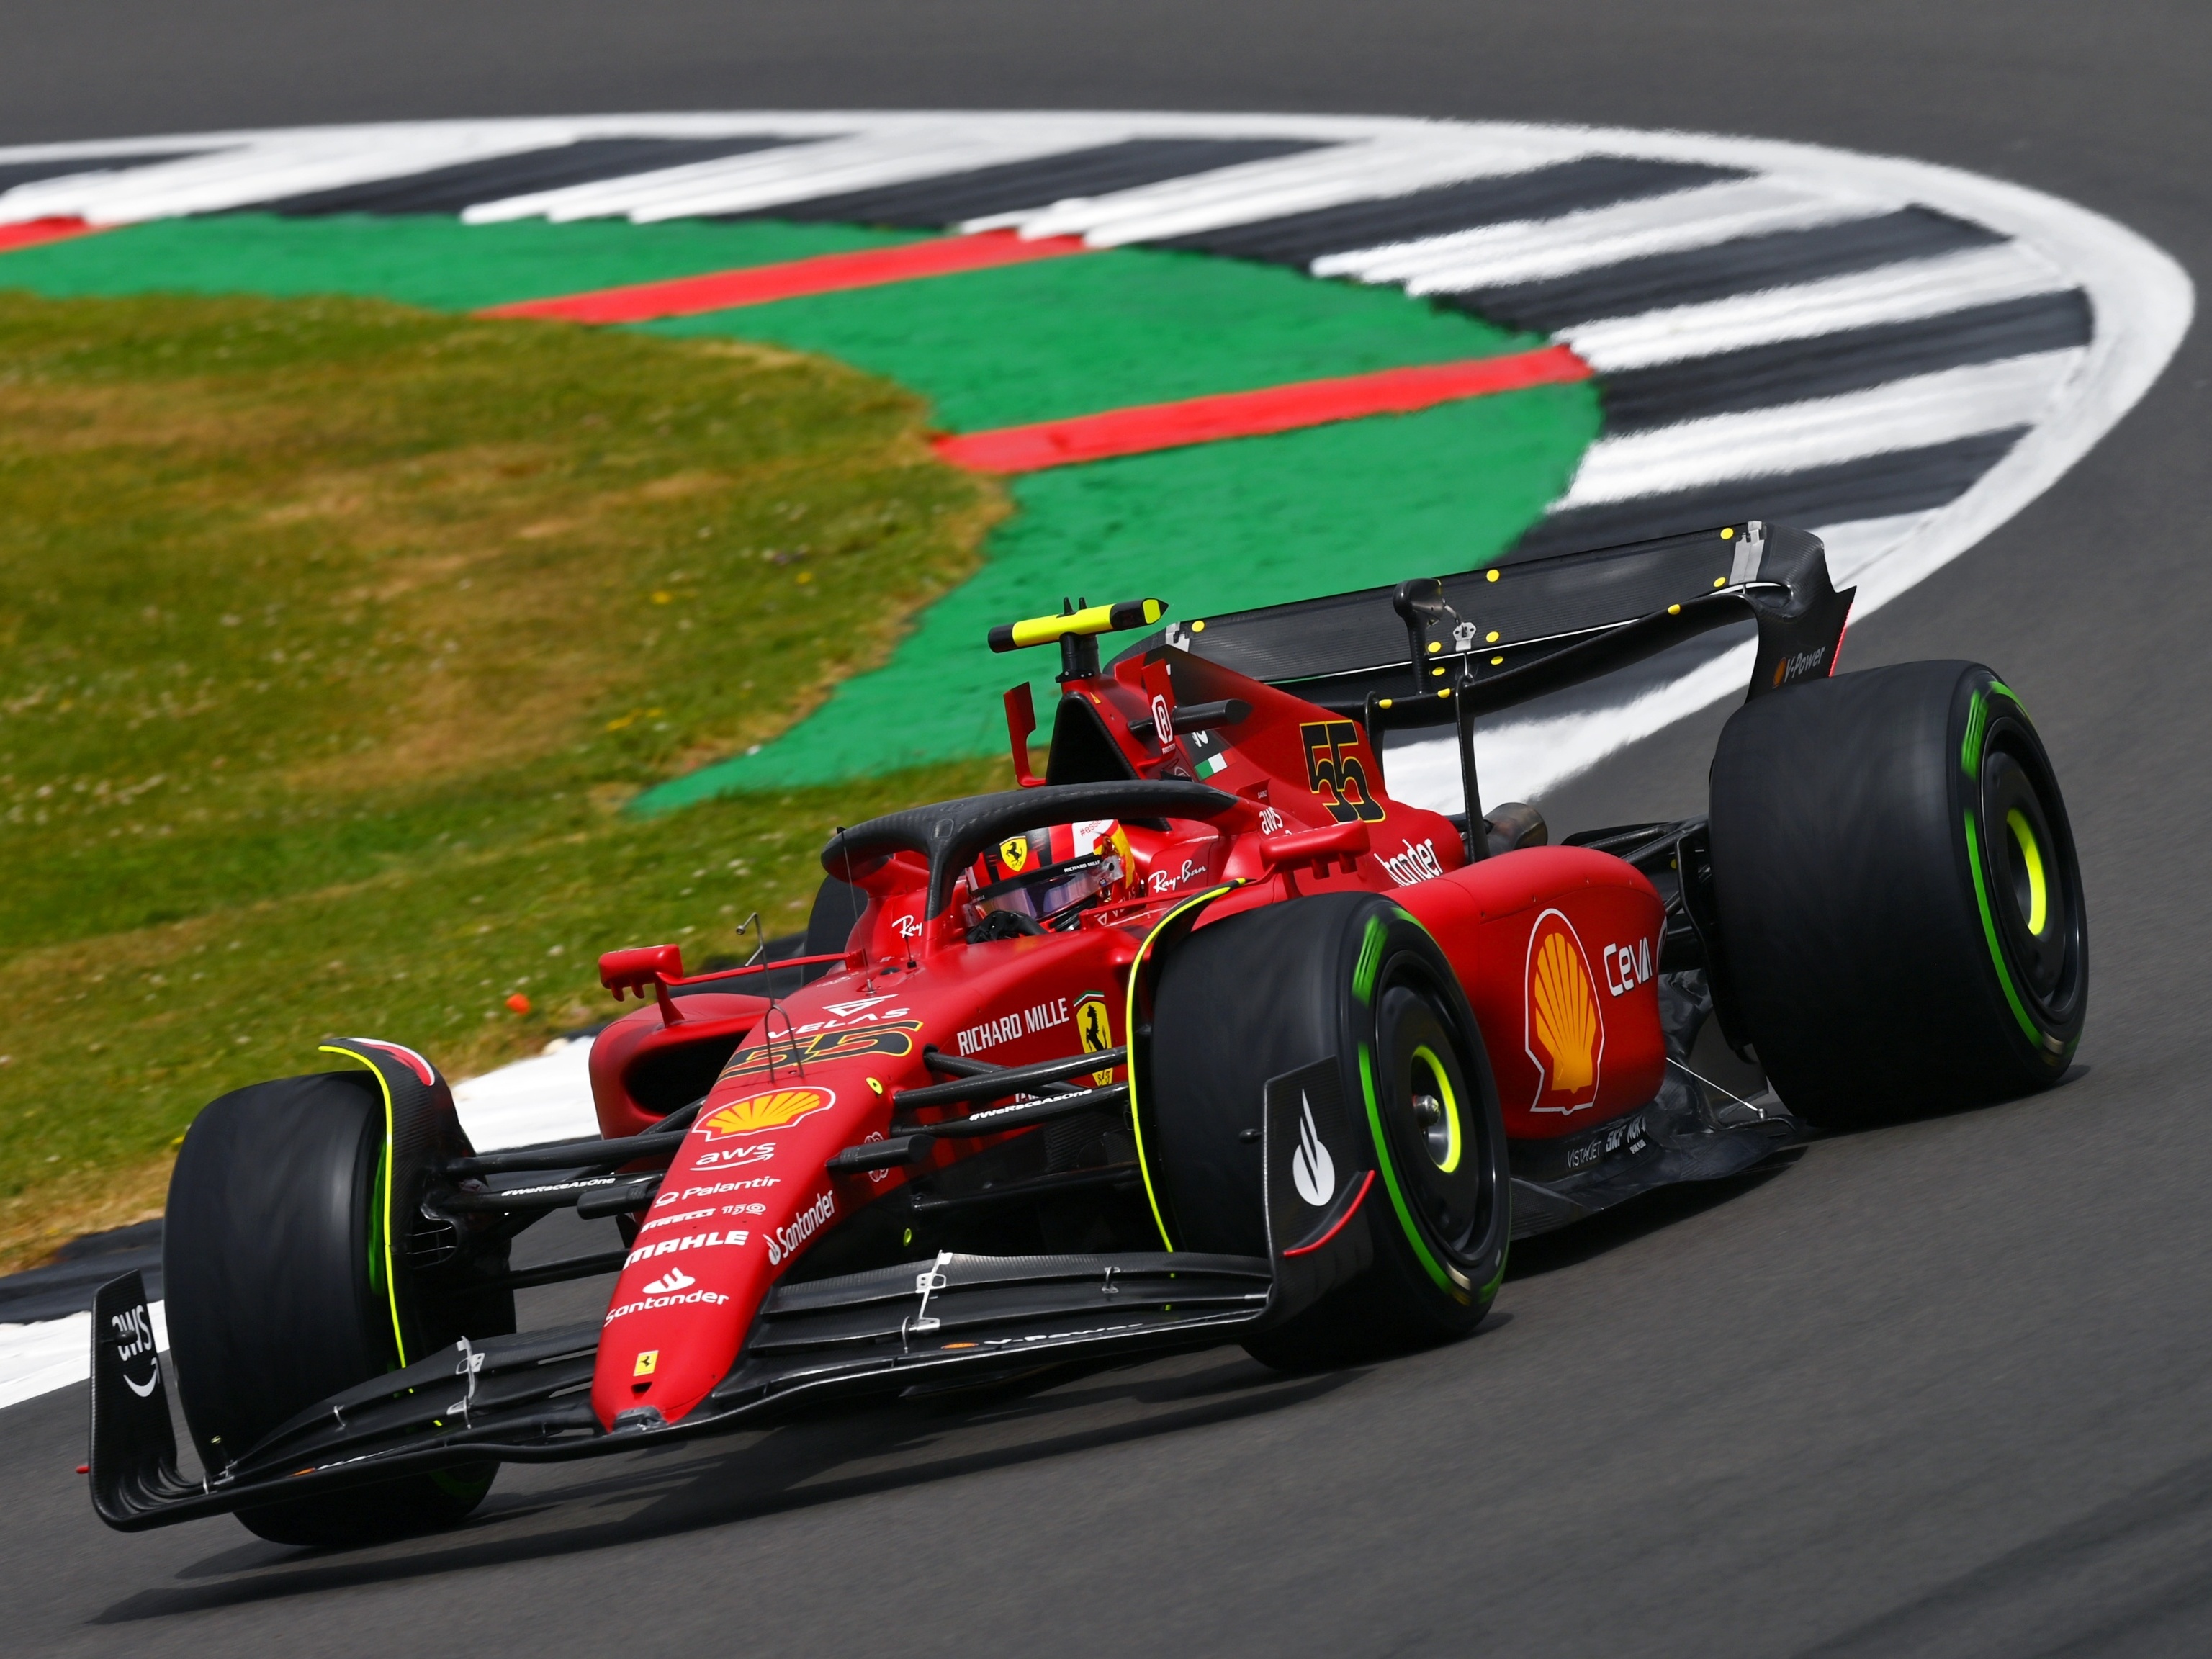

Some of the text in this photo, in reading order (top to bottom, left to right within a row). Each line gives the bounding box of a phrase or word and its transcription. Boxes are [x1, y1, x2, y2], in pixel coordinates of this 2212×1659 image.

[1784, 646, 1826, 683] V-Power
[1299, 719, 1386, 823] 55
[1259, 806, 1284, 835] aws
[1064, 863, 1087, 873] RICHARD
[1148, 859, 1207, 893] Ray-Ban
[1373, 838, 1443, 887] tander
[891, 914, 923, 938] Ray
[767, 1007, 911, 1039] VELAS
[956, 997, 1069, 1056] RICHARD MILLE
[714, 1020, 924, 1086] 55
[969, 1089, 1092, 1121] #WeRaceAsOne
[696, 1143, 777, 1166] aws
[1606, 1125, 1627, 1152] SKF
[501, 1178, 616, 1196] #WeRaceAsOne
[681, 1176, 781, 1200] Palantir
[640, 1208, 716, 1233] PIRELLI
[775, 1190, 835, 1259] Santander
[622, 1231, 750, 1270] MAHLE
[603, 1290, 730, 1327] Santander
[111, 1305, 153, 1361] aws
